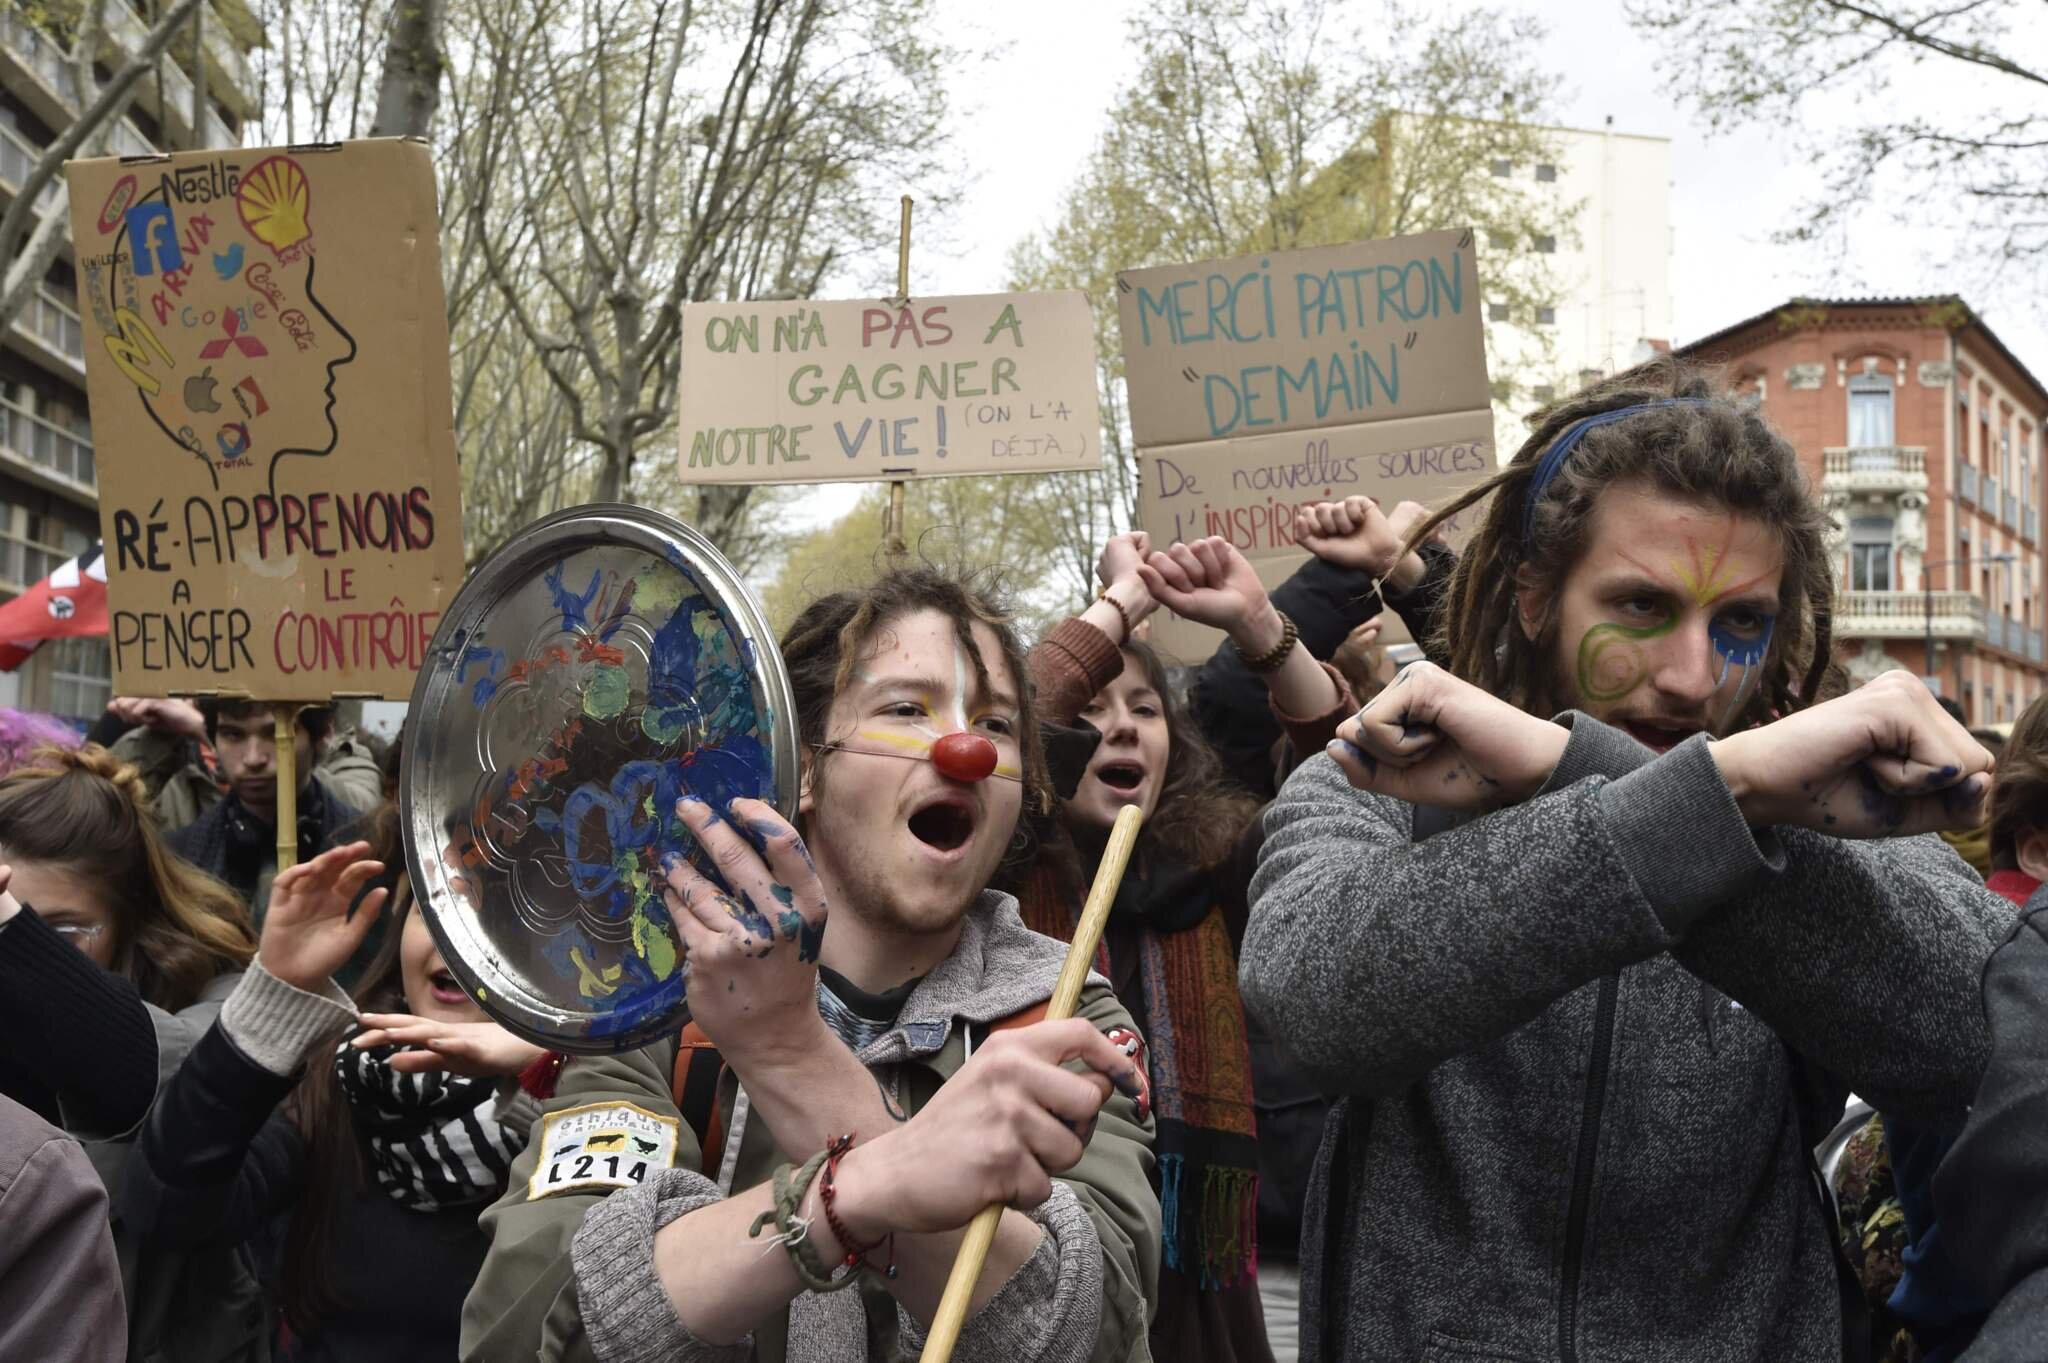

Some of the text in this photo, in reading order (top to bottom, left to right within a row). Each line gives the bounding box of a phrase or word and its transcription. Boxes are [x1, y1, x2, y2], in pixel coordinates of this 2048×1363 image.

[151, 211, 215, 326] AREVA
[182, 294, 267, 332] Gogle
[705, 314, 759, 353] ON
[861, 306, 953, 349] PAS
[983, 303, 1024, 347] A
[788, 356, 1021, 406] GAGNER
[964, 400, 1073, 429] (ON L'A
[215, 456, 253, 470] TOTAL
[688, 424, 813, 468] NOTRE
[1156, 458, 1204, 498] De
[1233, 439, 1359, 491] nouvelles
[114, 486, 434, 572] RÉ-APPRENONS
[172, 579, 191, 605] A
[324, 568, 357, 601] LE
[113, 608, 255, 673] PENSER
[274, 596, 440, 674] CONTRÔLE
[548, 1155, 648, 1184] L214
